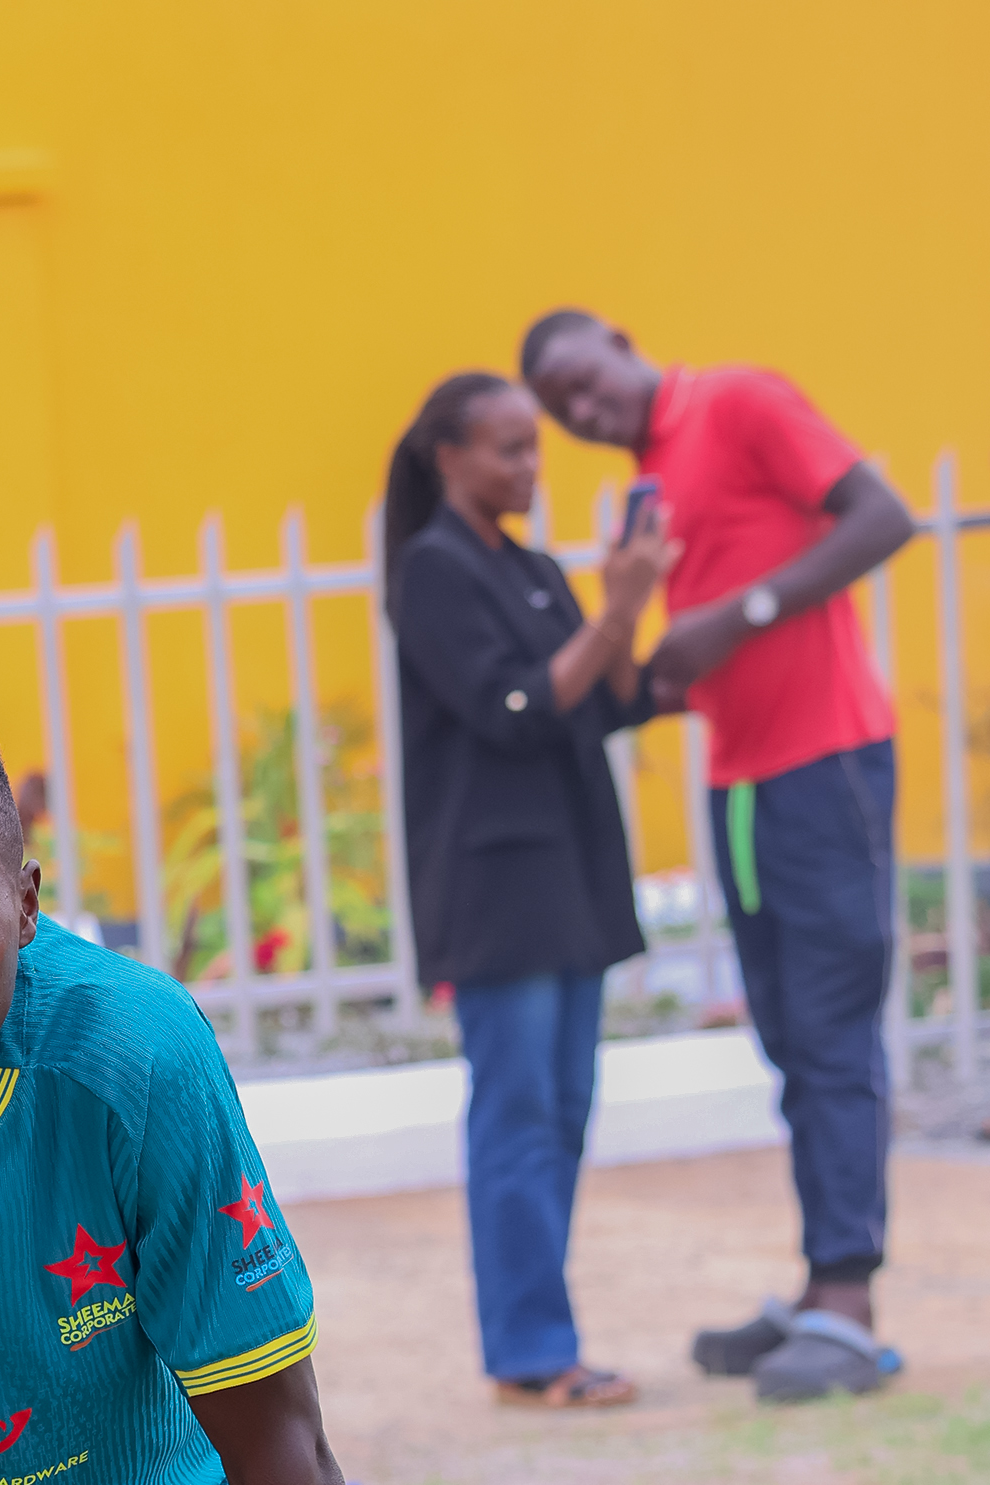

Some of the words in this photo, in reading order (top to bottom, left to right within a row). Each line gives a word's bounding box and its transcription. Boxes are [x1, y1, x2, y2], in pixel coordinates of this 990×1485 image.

[232, 1236, 283, 1274] SHEEA
[57, 1292, 135, 1333] SHEEMA
[60, 1302, 136, 1345] CORPORATE
